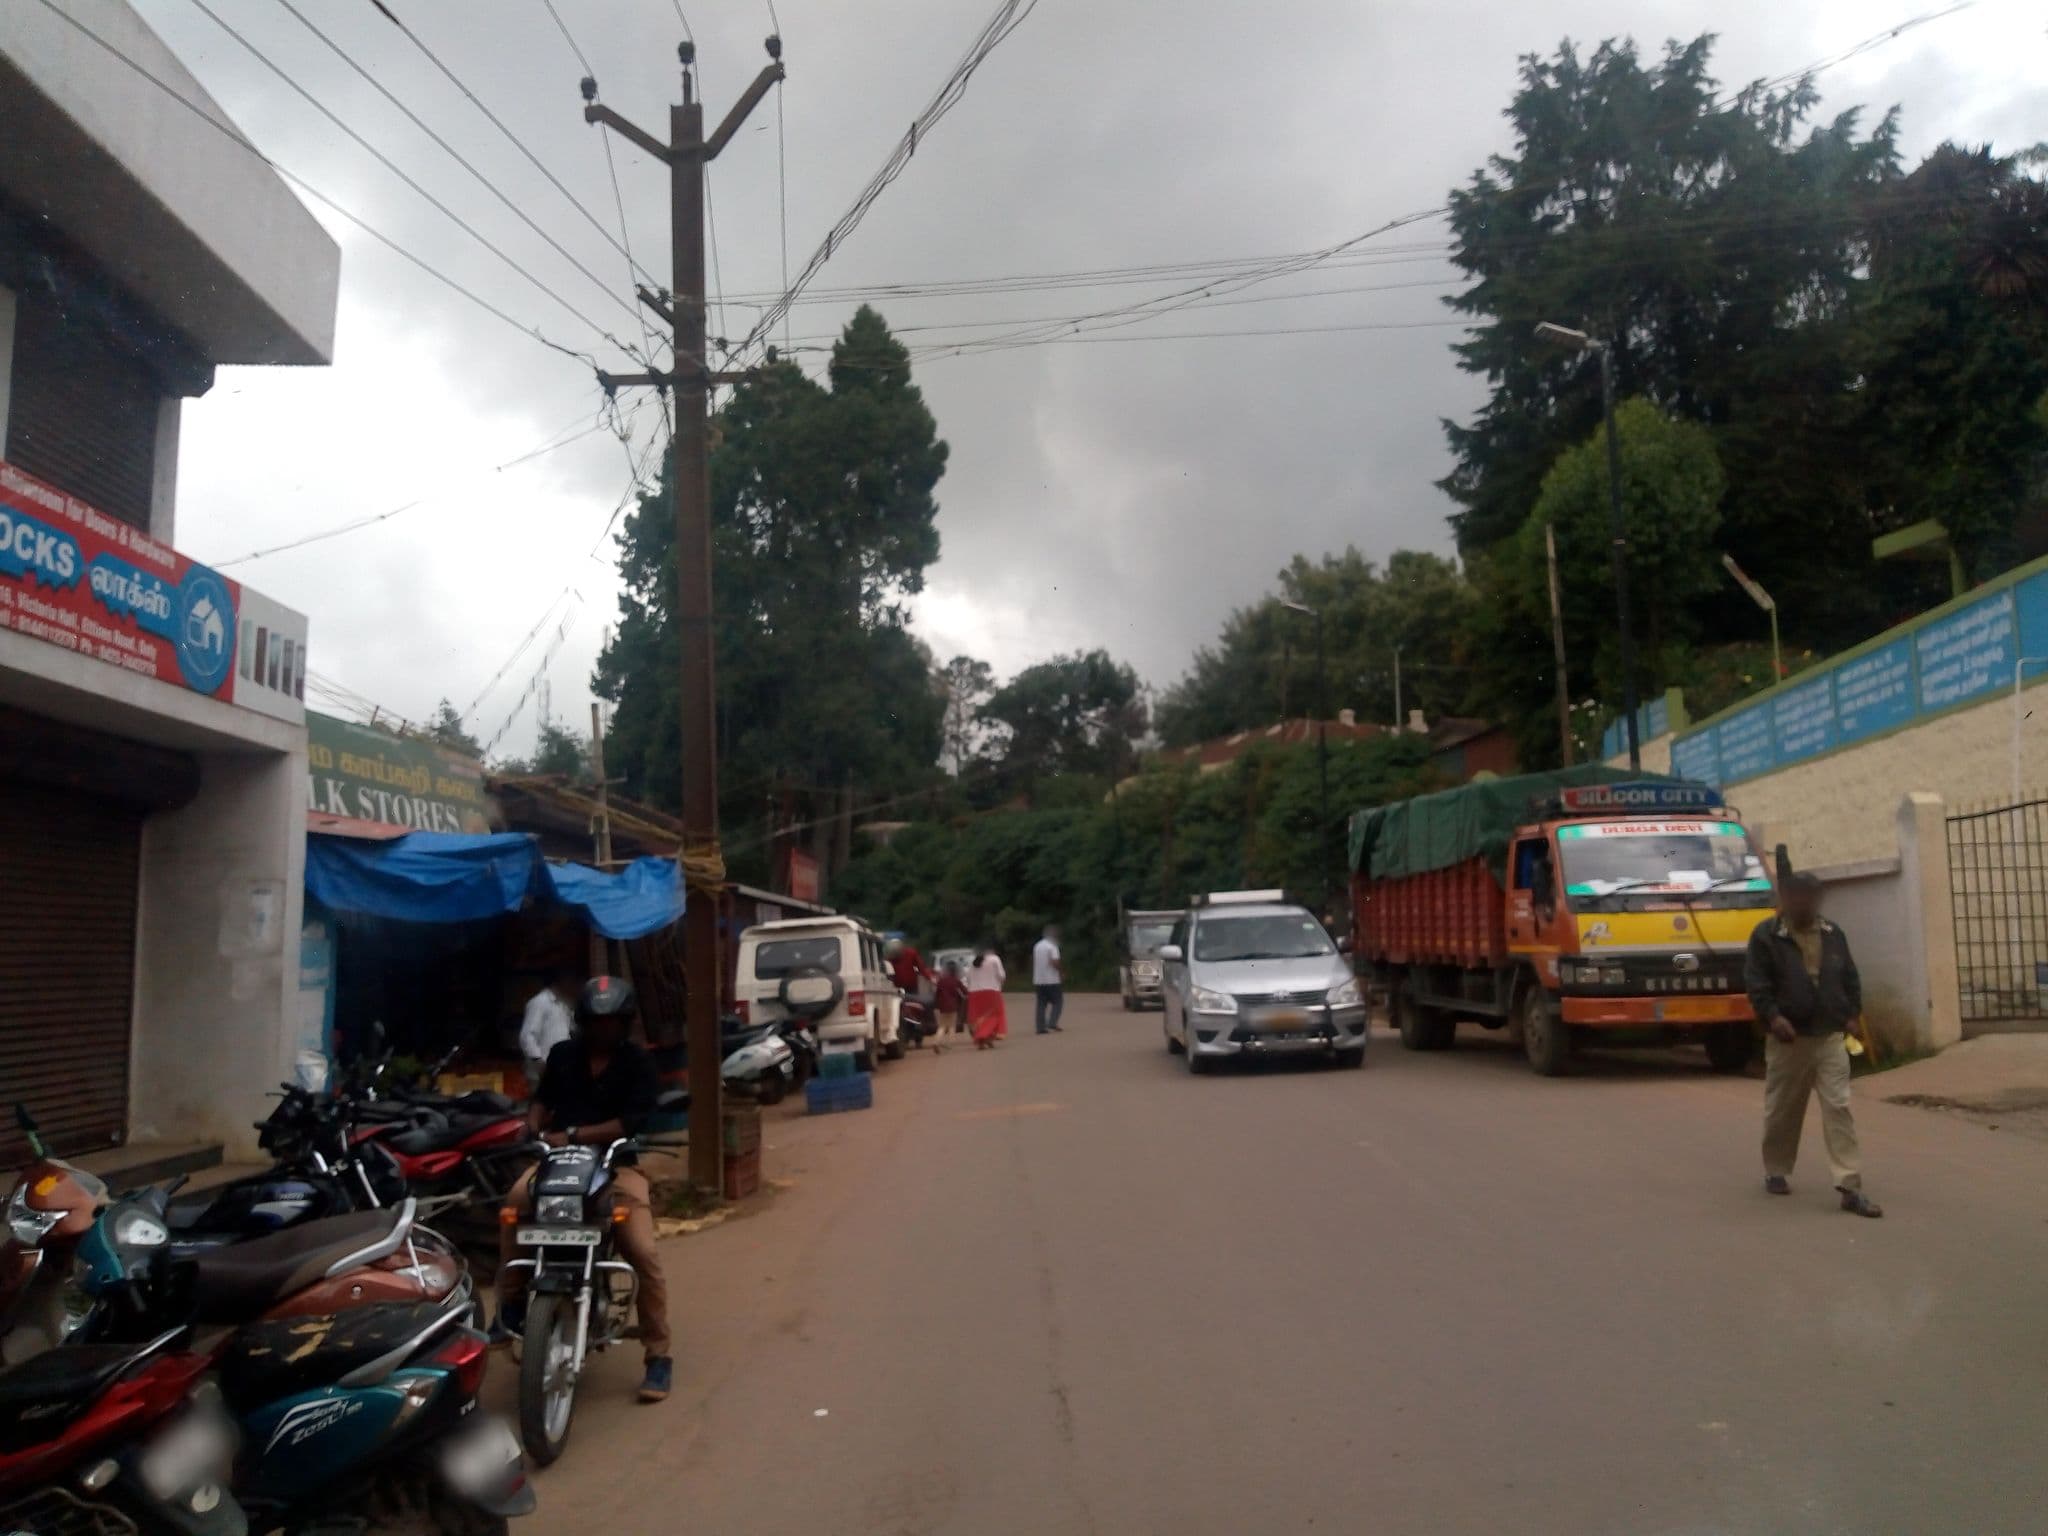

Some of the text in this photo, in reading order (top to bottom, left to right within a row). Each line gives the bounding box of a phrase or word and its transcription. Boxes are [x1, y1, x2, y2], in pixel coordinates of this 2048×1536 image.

[119, 525, 128, 546] &
[1578, 787, 1707, 805] SILICON CITY
[357, 785, 461, 833] STORES
